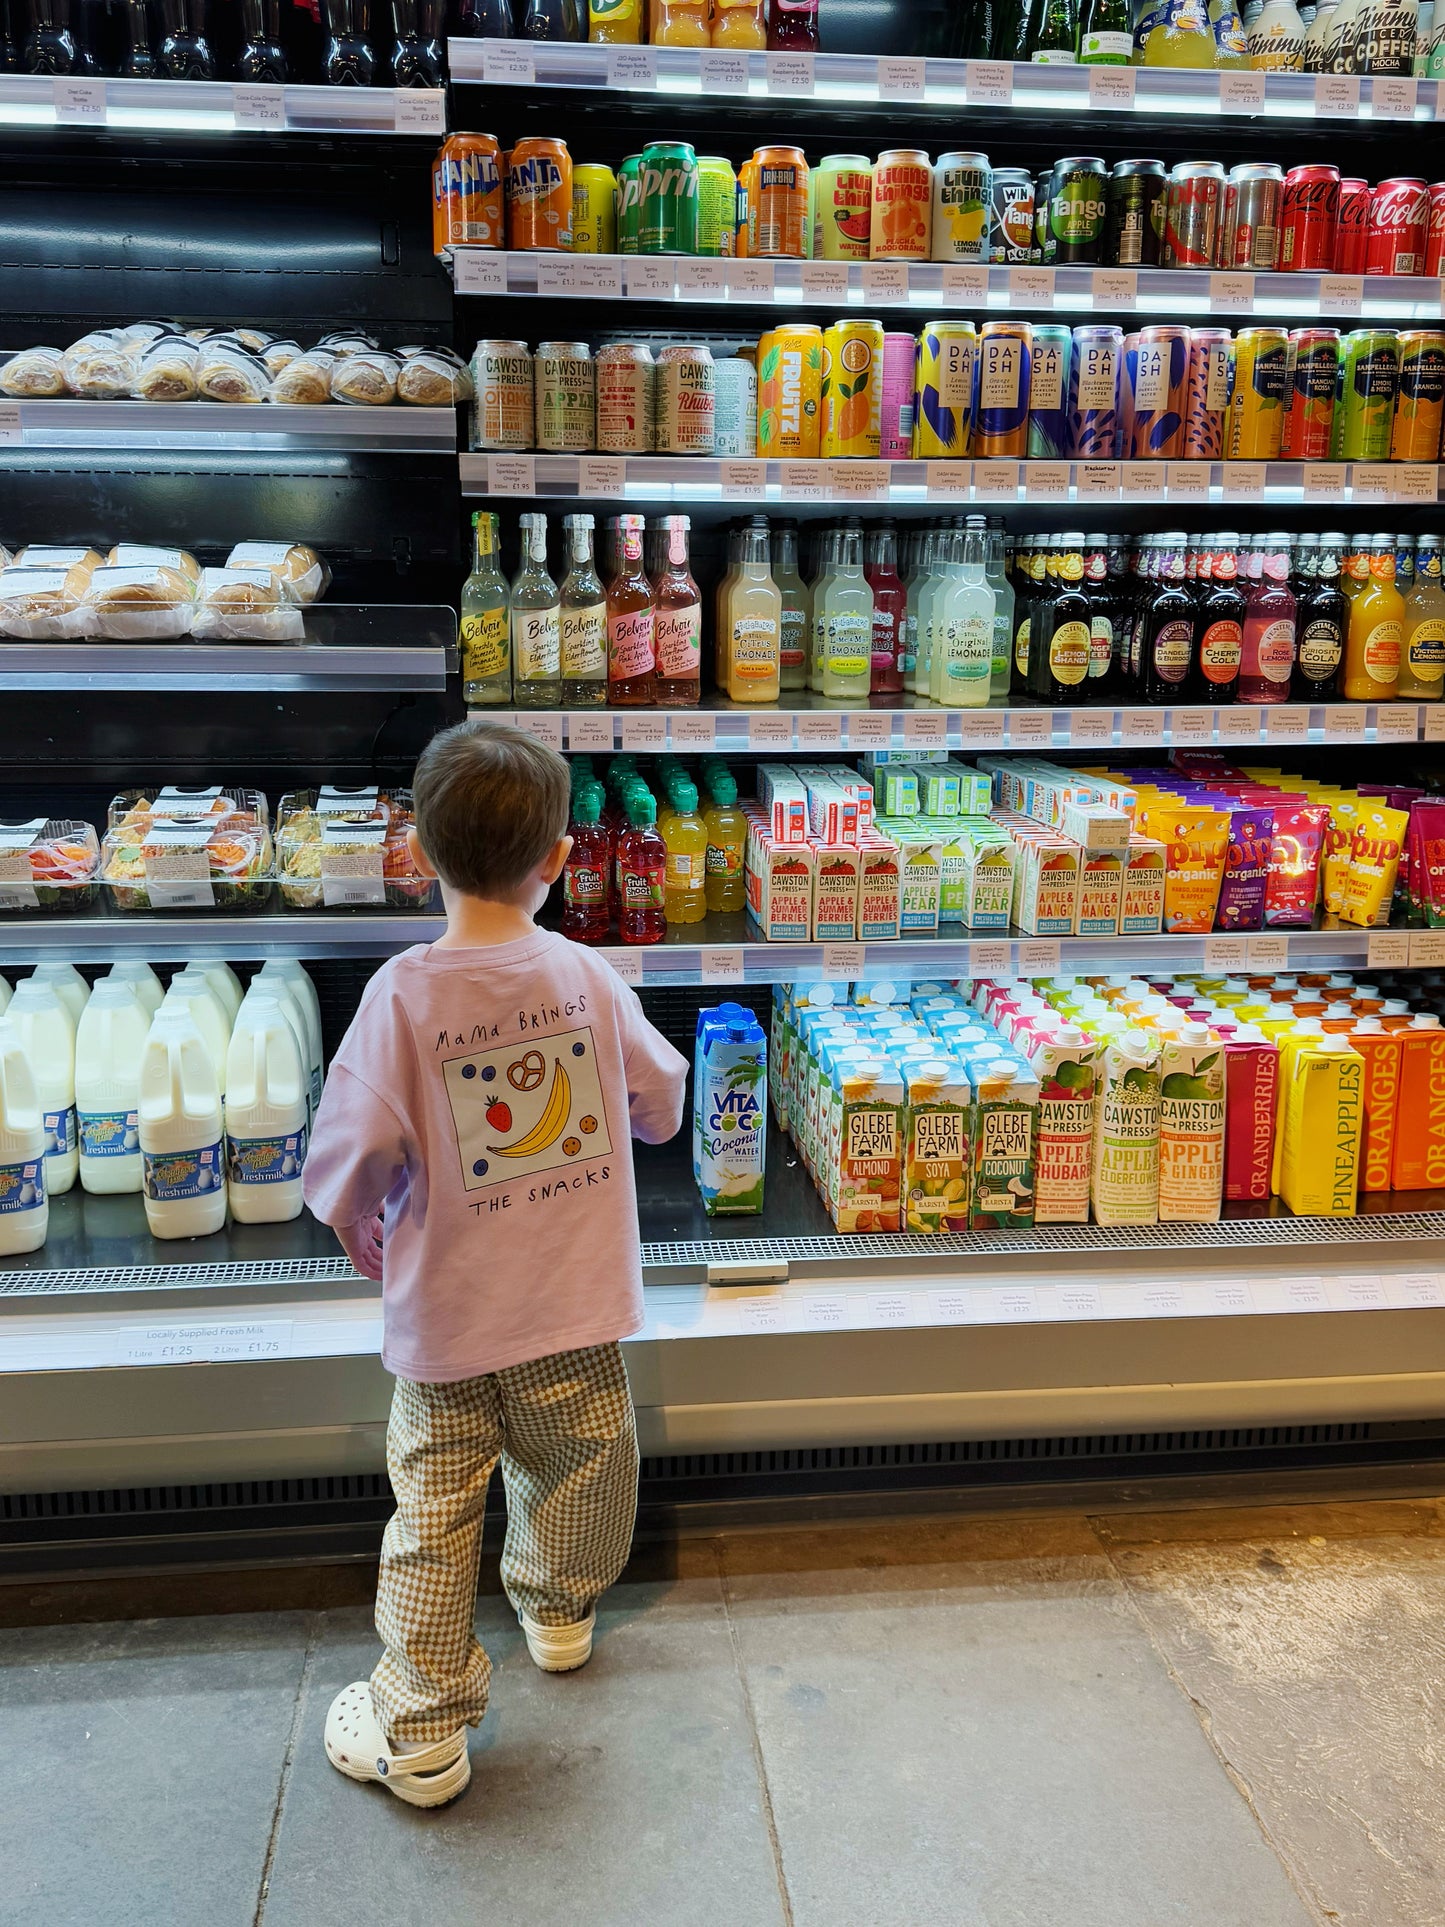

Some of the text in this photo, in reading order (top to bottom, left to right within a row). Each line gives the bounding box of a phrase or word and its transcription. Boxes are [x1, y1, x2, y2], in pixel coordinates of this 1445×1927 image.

[1357, 39, 1415, 60] COFFEE
[1372, 59, 1400, 67] MOCHA
[442, 155, 500, 187] FANTA
[878, 168, 929, 185] Living
[763, 170, 794, 184] IRN-BRU
[876, 184, 929, 202] things
[1006, 189, 1027, 200] WIN
[1052, 197, 1105, 220] Tango
[1067, 220, 1090, 229] APPLE
[989, 360, 1012, 373] SH
[1032, 361, 1056, 374] SH
[1087, 363, 1111, 376] SH
[1140, 365, 1161, 377] SH
[501, 375, 524, 384] PRESS
[559, 377, 582, 386] PRESS
[1416, 488, 1432, 496] £1.95
[465, 619, 501, 640] Belvoir
[563, 619, 599, 640] Belvoir
[616, 619, 651, 640] Belvoir
[658, 619, 692, 640] Belvoir
[734, 650, 776, 660] LEMONADE
[828, 646, 870, 655] LEMONADE
[947, 649, 991, 659] LEMONADE
[1057, 650, 1087, 658] LEMON
[1205, 649, 1240, 657] CHERRY
[1301, 647, 1340, 655] CURIOSITY
[1210, 656, 1236, 664] COLA
[1305, 653, 1335, 662] COLA
[708, 850, 724, 859] Fruit
[1166, 839, 1228, 870] pip
[1350, 836, 1400, 868] pip
[707, 858, 726, 867] Shoot
[904, 865, 939, 876] CAWSTON
[976, 866, 1012, 877] CAWSTON
[1350, 860, 1384, 878] organic
[579, 874, 600, 884] Fruit
[864, 875, 899, 886] CAWSTON
[1040, 871, 1076, 882] CAWSTON
[1084, 872, 1121, 883] CAWSTON
[1127, 870, 1163, 880] CAWSTON
[1168, 869, 1218, 883] organic
[1226, 867, 1267, 883] organic
[627, 877, 647, 887] Fruit
[772, 876, 808, 886] CAWSTON
[819, 875, 856, 887] CAWSTON
[578, 882, 604, 892] Shoot
[626, 885, 651, 896] Shoot
[903, 886, 936, 897] APPLE &
[975, 887, 1009, 897] APPLE &
[772, 897, 807, 906] APPLE &
[819, 896, 854, 905] APPLE &
[864, 896, 890, 905] APPLE
[1039, 892, 1074, 903] APPLE &
[1083, 893, 1118, 904] APPLE &
[1126, 891, 1161, 902] APPLE &
[771, 905, 808, 914] SUMMER
[818, 904, 854, 914] SUMMER
[863, 904, 898, 913] SUMMER
[903, 897, 936, 911] PEAR
[974, 897, 1008, 911] PEAR
[1038, 905, 1073, 917] MANGO
[1082, 905, 1118, 918] MANGO
[1125, 904, 1161, 916] MANGO
[771, 914, 808, 922] BERRIES
[818, 913, 854, 922] BERRIES
[863, 912, 898, 922] BERRIES
[1312, 1063, 1329, 1071] EAGER
[713, 1090, 760, 1113] VITA
[1161, 1100, 1224, 1120] CAWSTON
[1365, 1044, 1398, 1187] ORANGES
[1426, 1040, 1445, 1184] ORANGES
[709, 1113, 763, 1133] COCO
[851, 1114, 893, 1134] GLEBE
[917, 1115, 959, 1135] GLEBE
[986, 1115, 1029, 1134] GLEBE
[1053, 1122, 1082, 1132] PRESS
[1179, 1121, 1208, 1131] PRESS
[1250, 1053, 1276, 1198] CRANBERRIES
[1121, 1126, 1150, 1136] PRESS
[1332, 1062, 1361, 1210] PINEAPPLES
[711, 1129, 759, 1155] Coconut
[851, 1135, 892, 1152] FARM
[918, 1137, 959, 1155] FARM
[986, 1135, 1027, 1153] FARM
[86, 1144, 127, 1154] fresh milk
[735, 1147, 759, 1156] WATER
[1160, 1144, 1222, 1164] APPLE
[1102, 1150, 1151, 1171] APPLE
[852, 1160, 890, 1176] ALMOND
[926, 1164, 950, 1178] SOYA
[985, 1160, 1027, 1176] COCONUT
[1172, 1166, 1221, 1180] GINGER
[241, 1170, 284, 1181] fresh milk
[157, 1184, 201, 1198] fresh milk
[2, 1199, 22, 1210] milk
[469, 1195, 511, 1216] THE
[147, 1326, 264, 1339] Locally Supplied Fresh Milk
[161, 1346, 193, 1357] £1.25
[248, 1342, 279, 1353] £1.75
